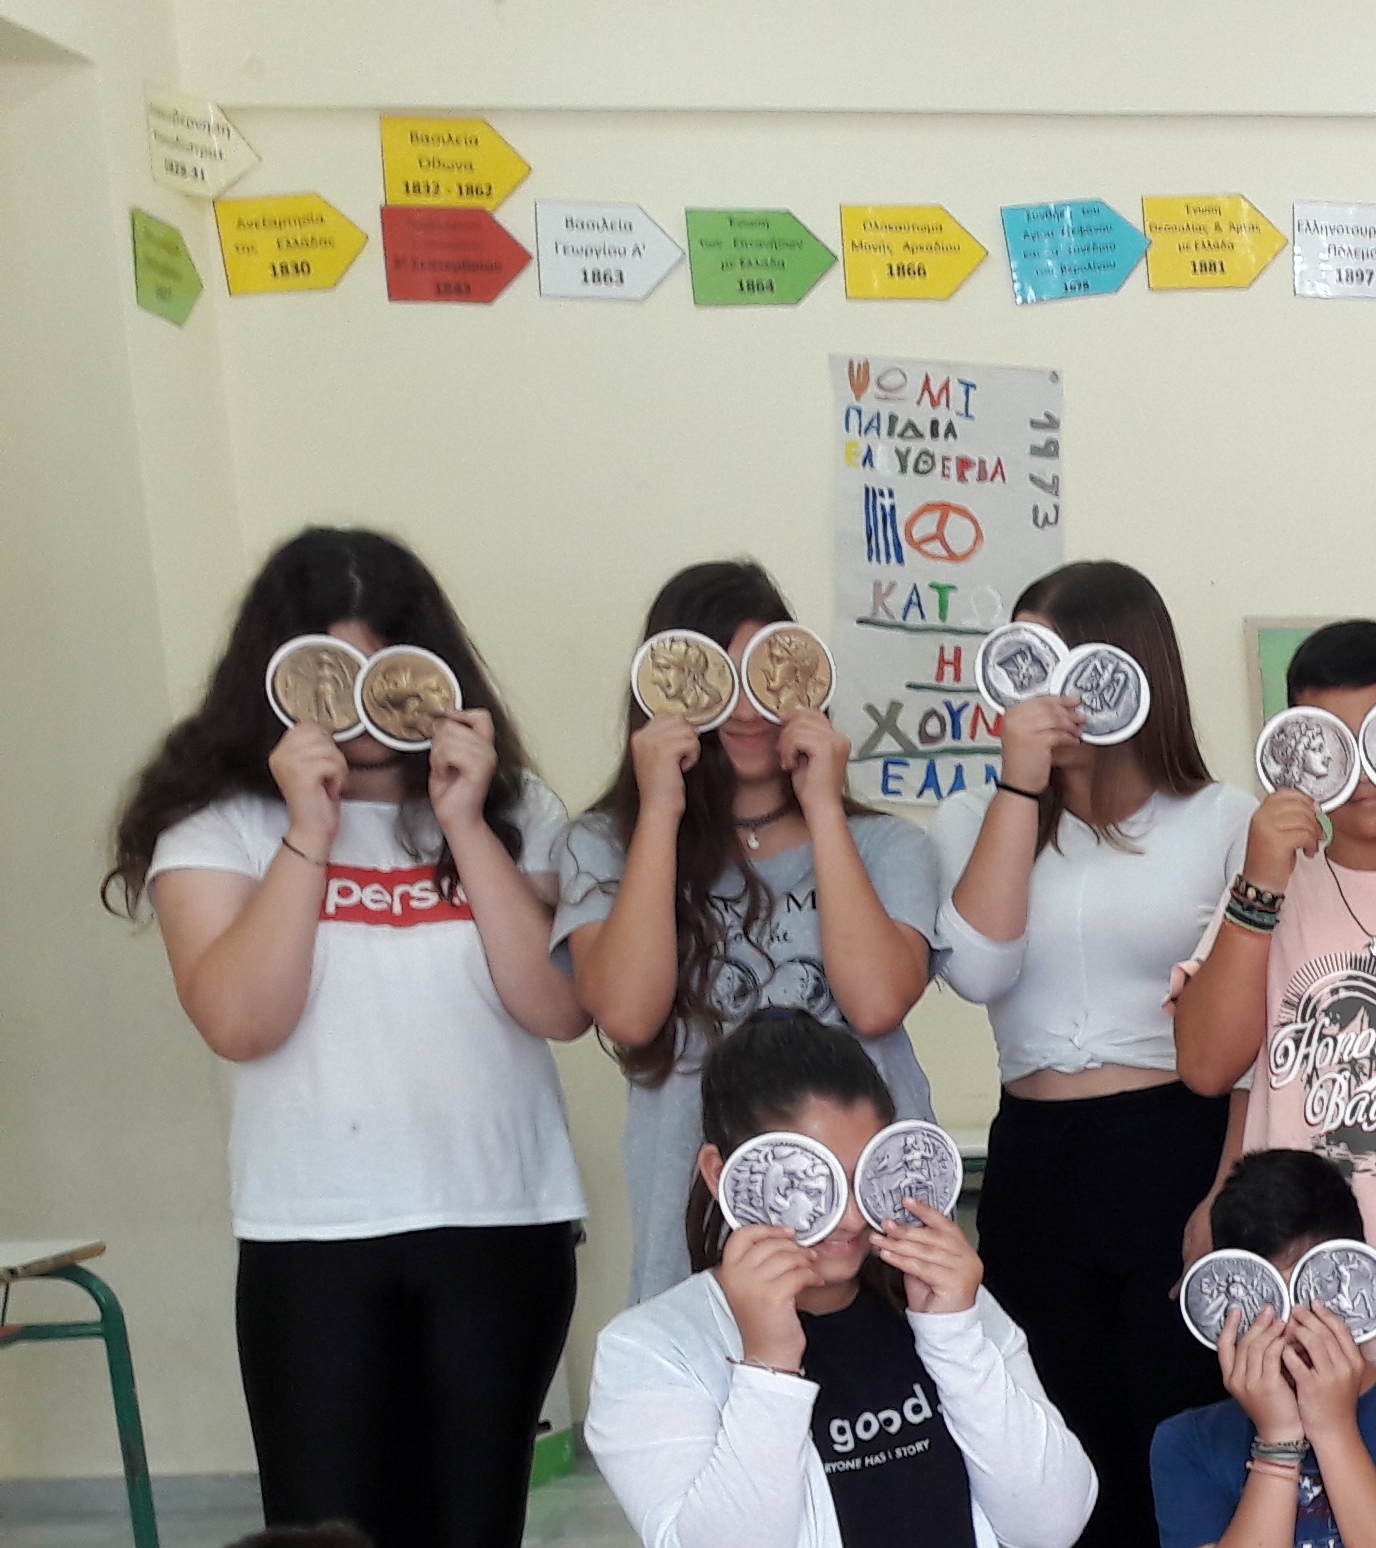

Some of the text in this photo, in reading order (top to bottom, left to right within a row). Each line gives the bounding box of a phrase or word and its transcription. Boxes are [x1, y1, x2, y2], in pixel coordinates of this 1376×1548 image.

[1190, 259, 1227, 276] 1881
[1335, 267, 1375, 286] 1897
[845, 441, 1006, 485] ΕΛΥΘΕΡΙΑ
[1028, 410, 1061, 530] 1973
[829, 1382, 933, 1453] good
[894, 1437, 931, 1460] STORY
